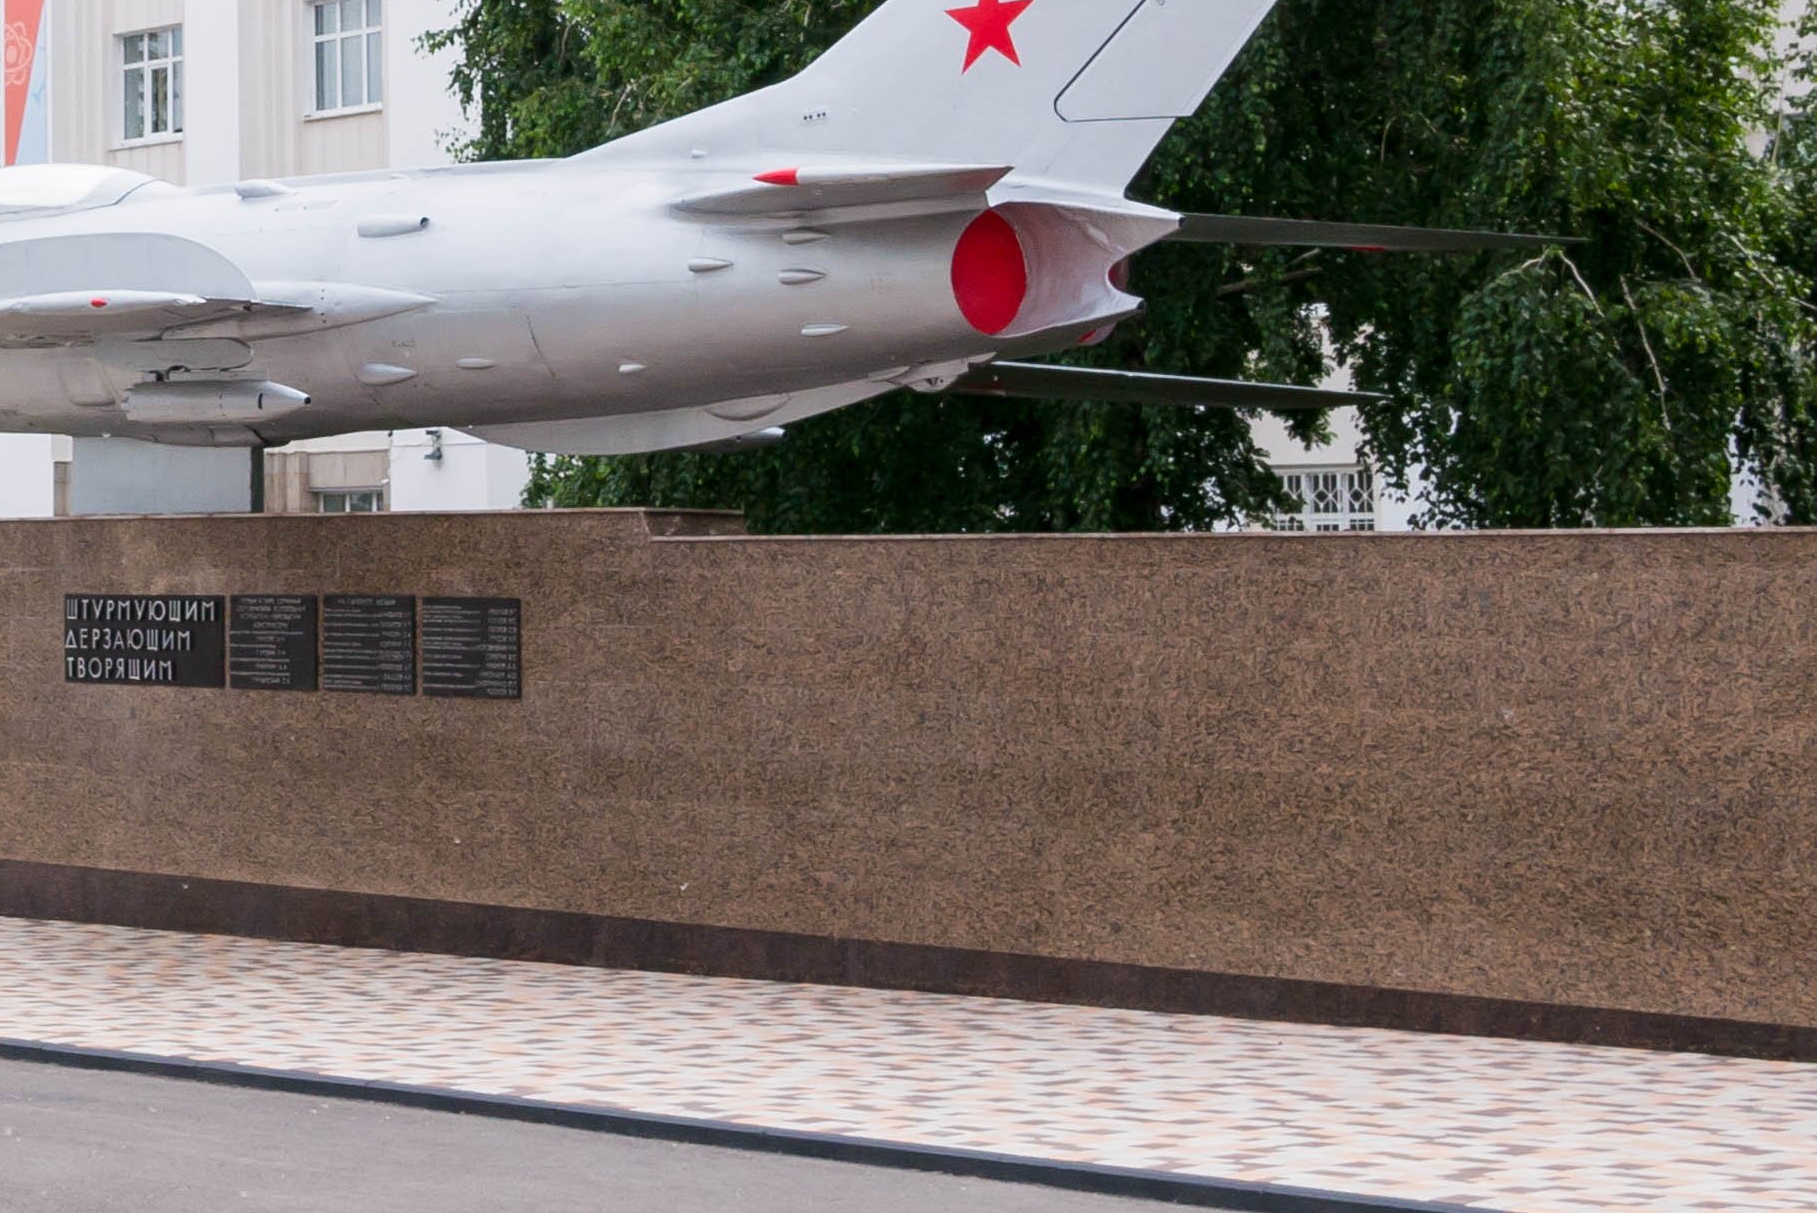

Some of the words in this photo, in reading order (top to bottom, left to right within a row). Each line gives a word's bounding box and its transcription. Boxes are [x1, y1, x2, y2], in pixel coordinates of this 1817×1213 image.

[66, 598, 215, 622] ШТУРМУЮЩИМ
[65, 628, 191, 651] ДЕРЗАЮЩИМ
[66, 656, 173, 681] ТВОРЯЩИМ
